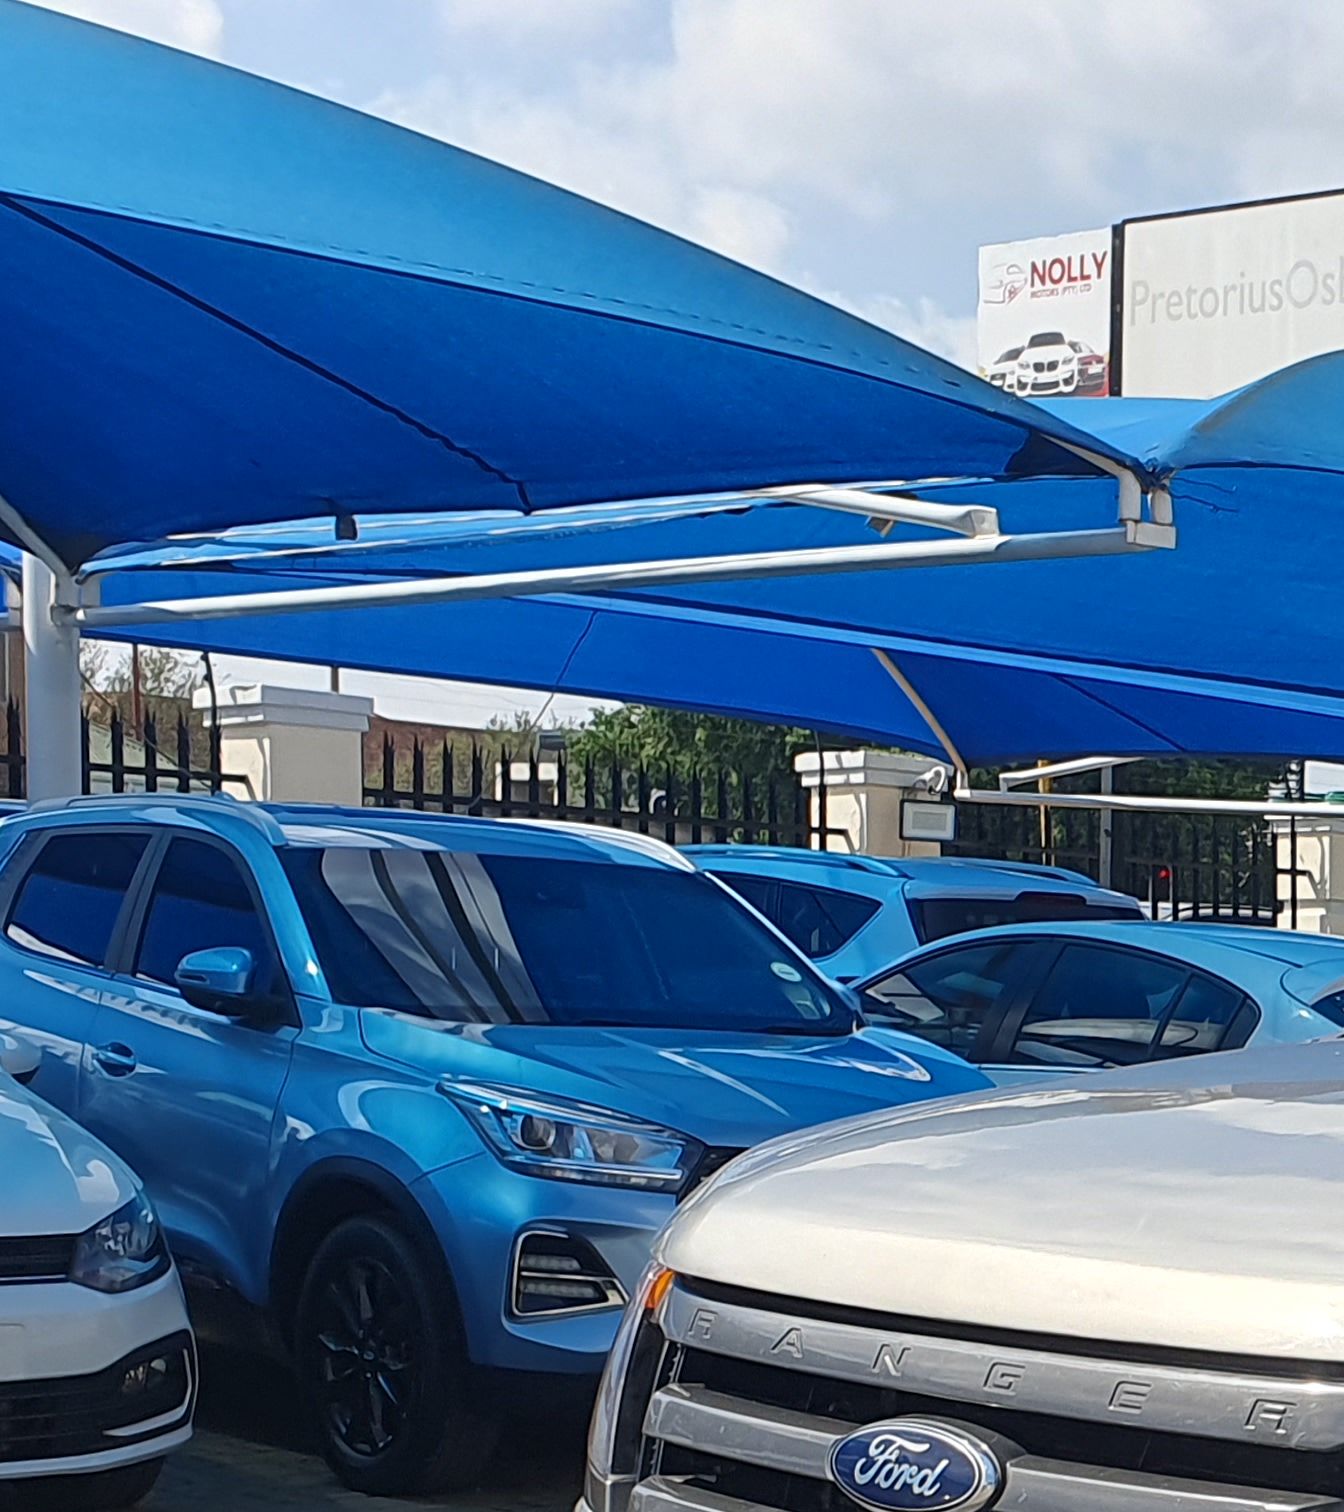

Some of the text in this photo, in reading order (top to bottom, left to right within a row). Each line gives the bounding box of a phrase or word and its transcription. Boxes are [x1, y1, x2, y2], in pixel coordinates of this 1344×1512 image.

[1030, 250, 1108, 288] NOLLY
[1030, 287, 1059, 299] MOTORS
[1080, 283, 1092, 294] LTD
[687, 1308, 1298, 1435] RANGER
[854, 1434, 949, 1497] Ford
